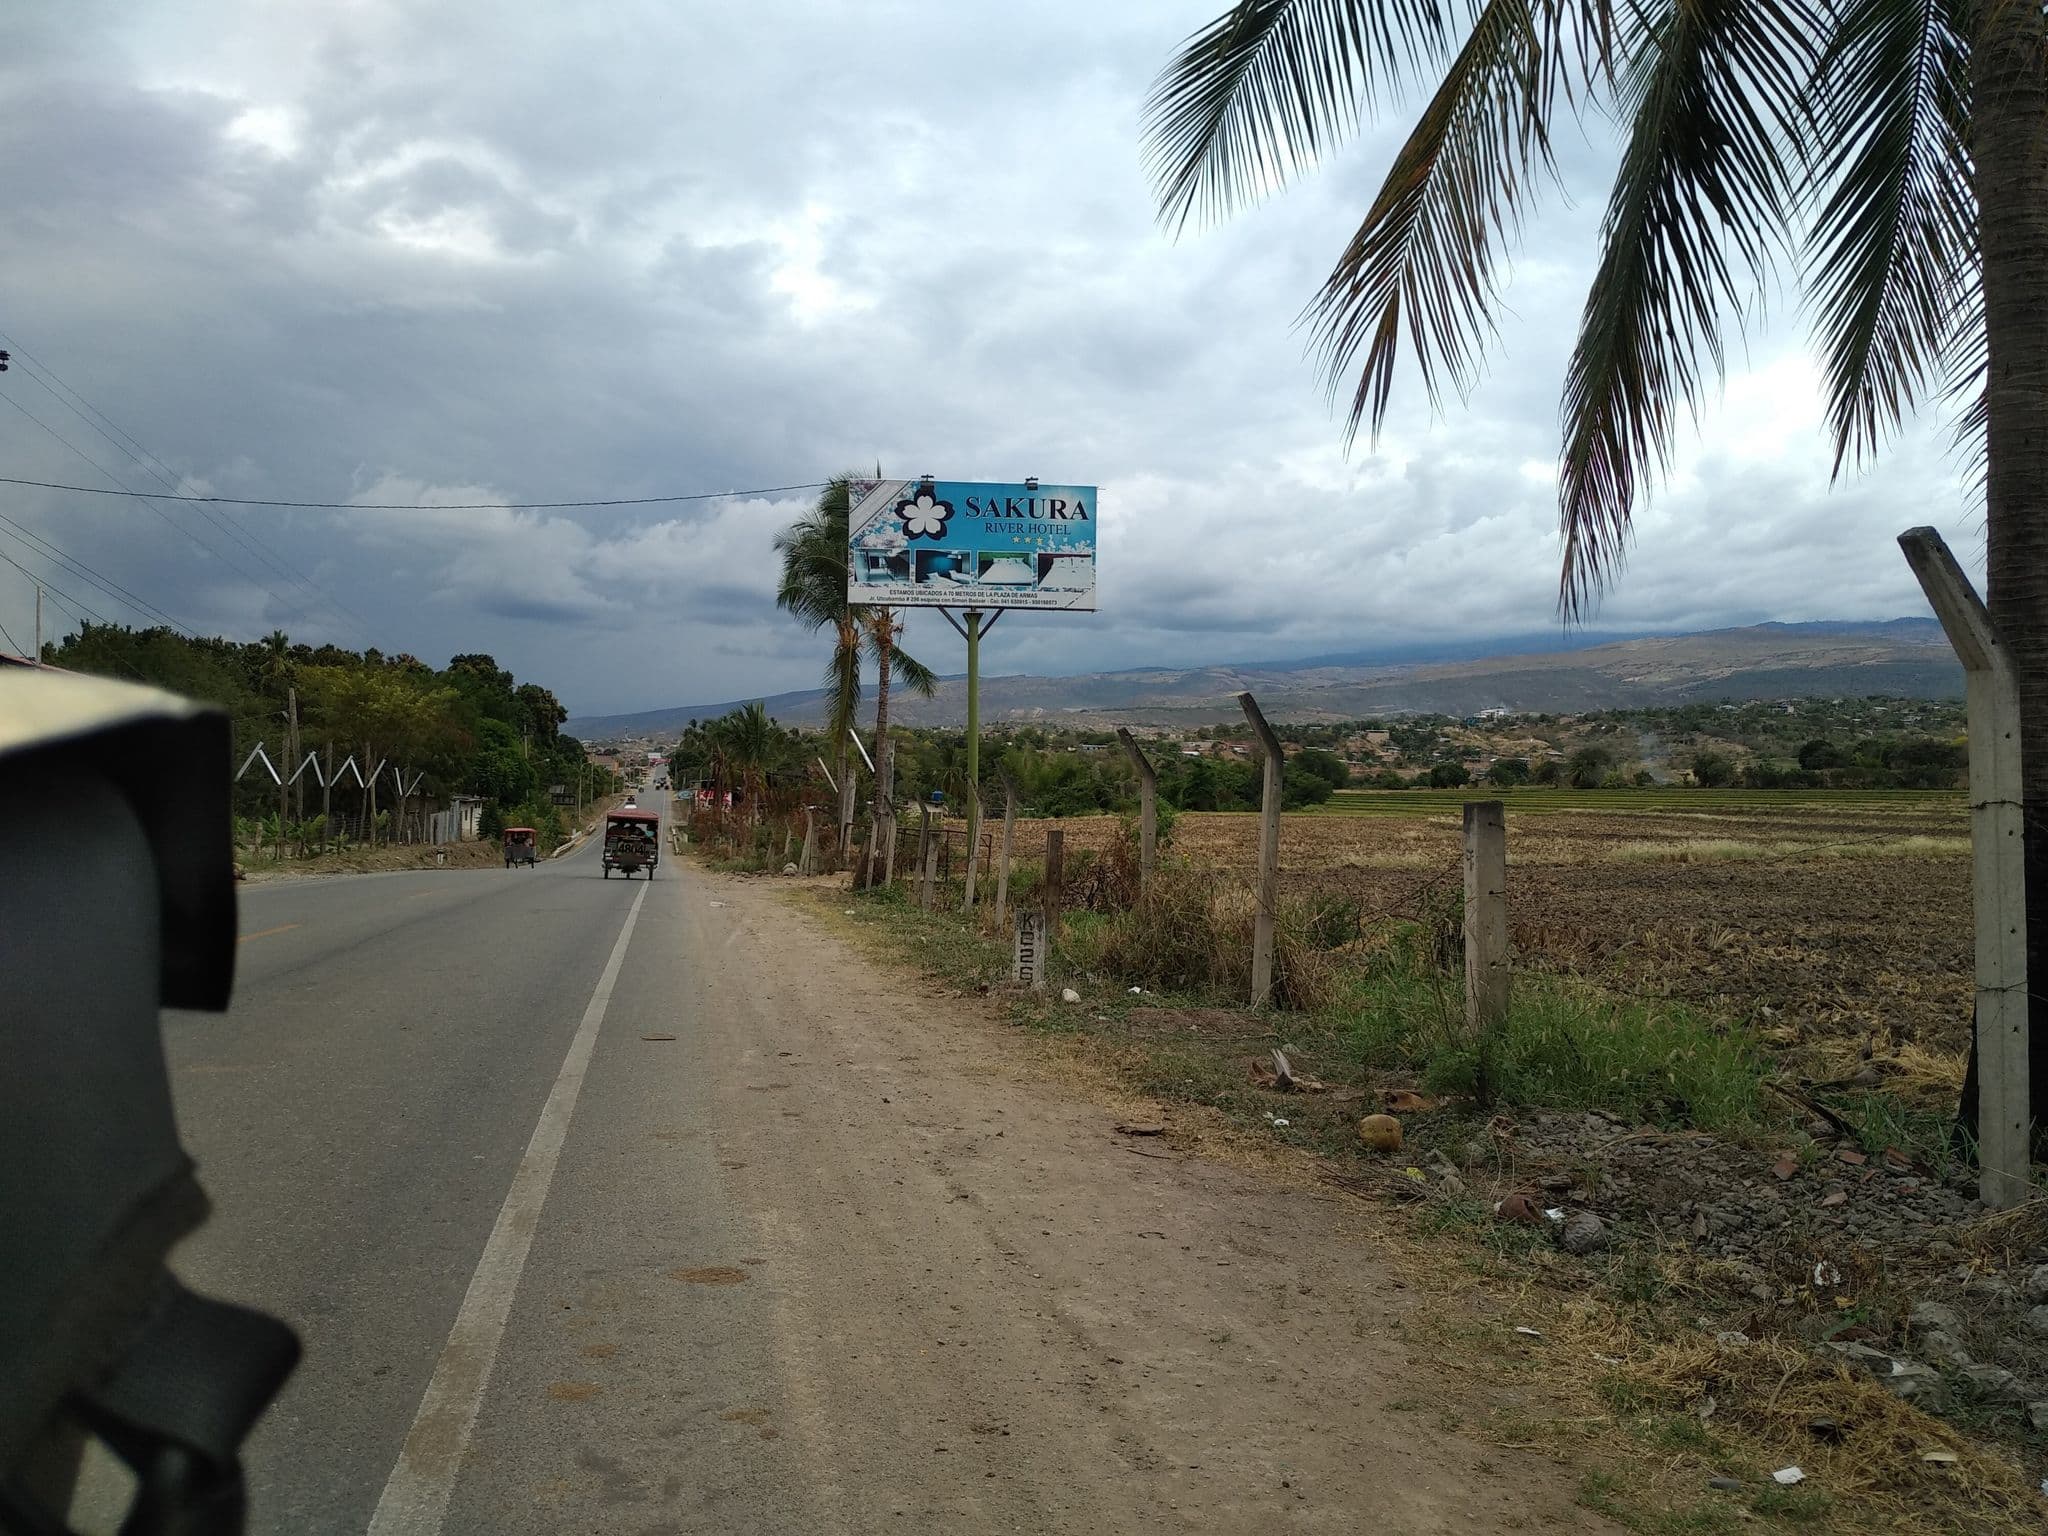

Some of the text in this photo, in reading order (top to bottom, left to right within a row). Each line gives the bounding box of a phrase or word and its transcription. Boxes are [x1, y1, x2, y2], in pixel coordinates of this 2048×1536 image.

[965, 496, 1089, 521] SAKURA
[985, 522, 1071, 535] RIVER HOTEL
